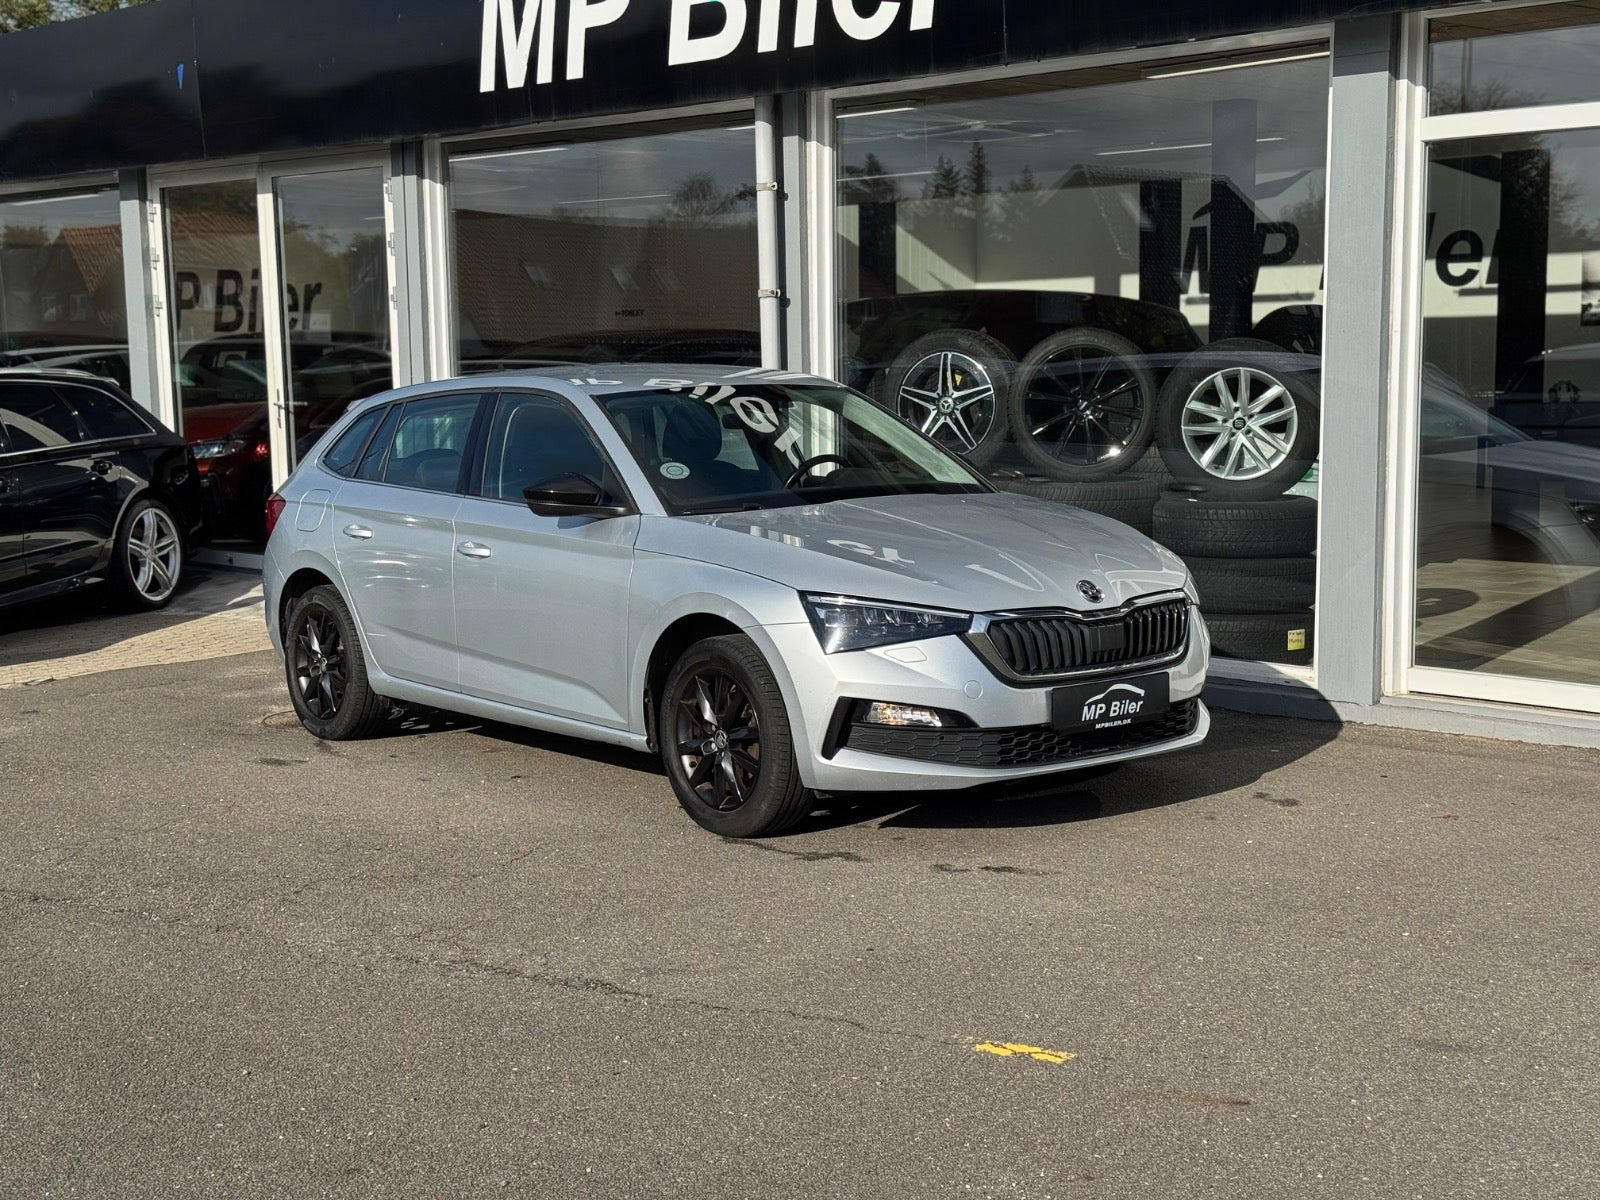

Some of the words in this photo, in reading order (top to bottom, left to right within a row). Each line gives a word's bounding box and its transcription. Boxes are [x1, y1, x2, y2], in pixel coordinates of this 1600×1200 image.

[214, 268, 323, 332] Bier
[1081, 703, 1106, 722] MP
[1109, 699, 1144, 717] Biler
[1095, 718, 1132, 729] MPBILER.DK
